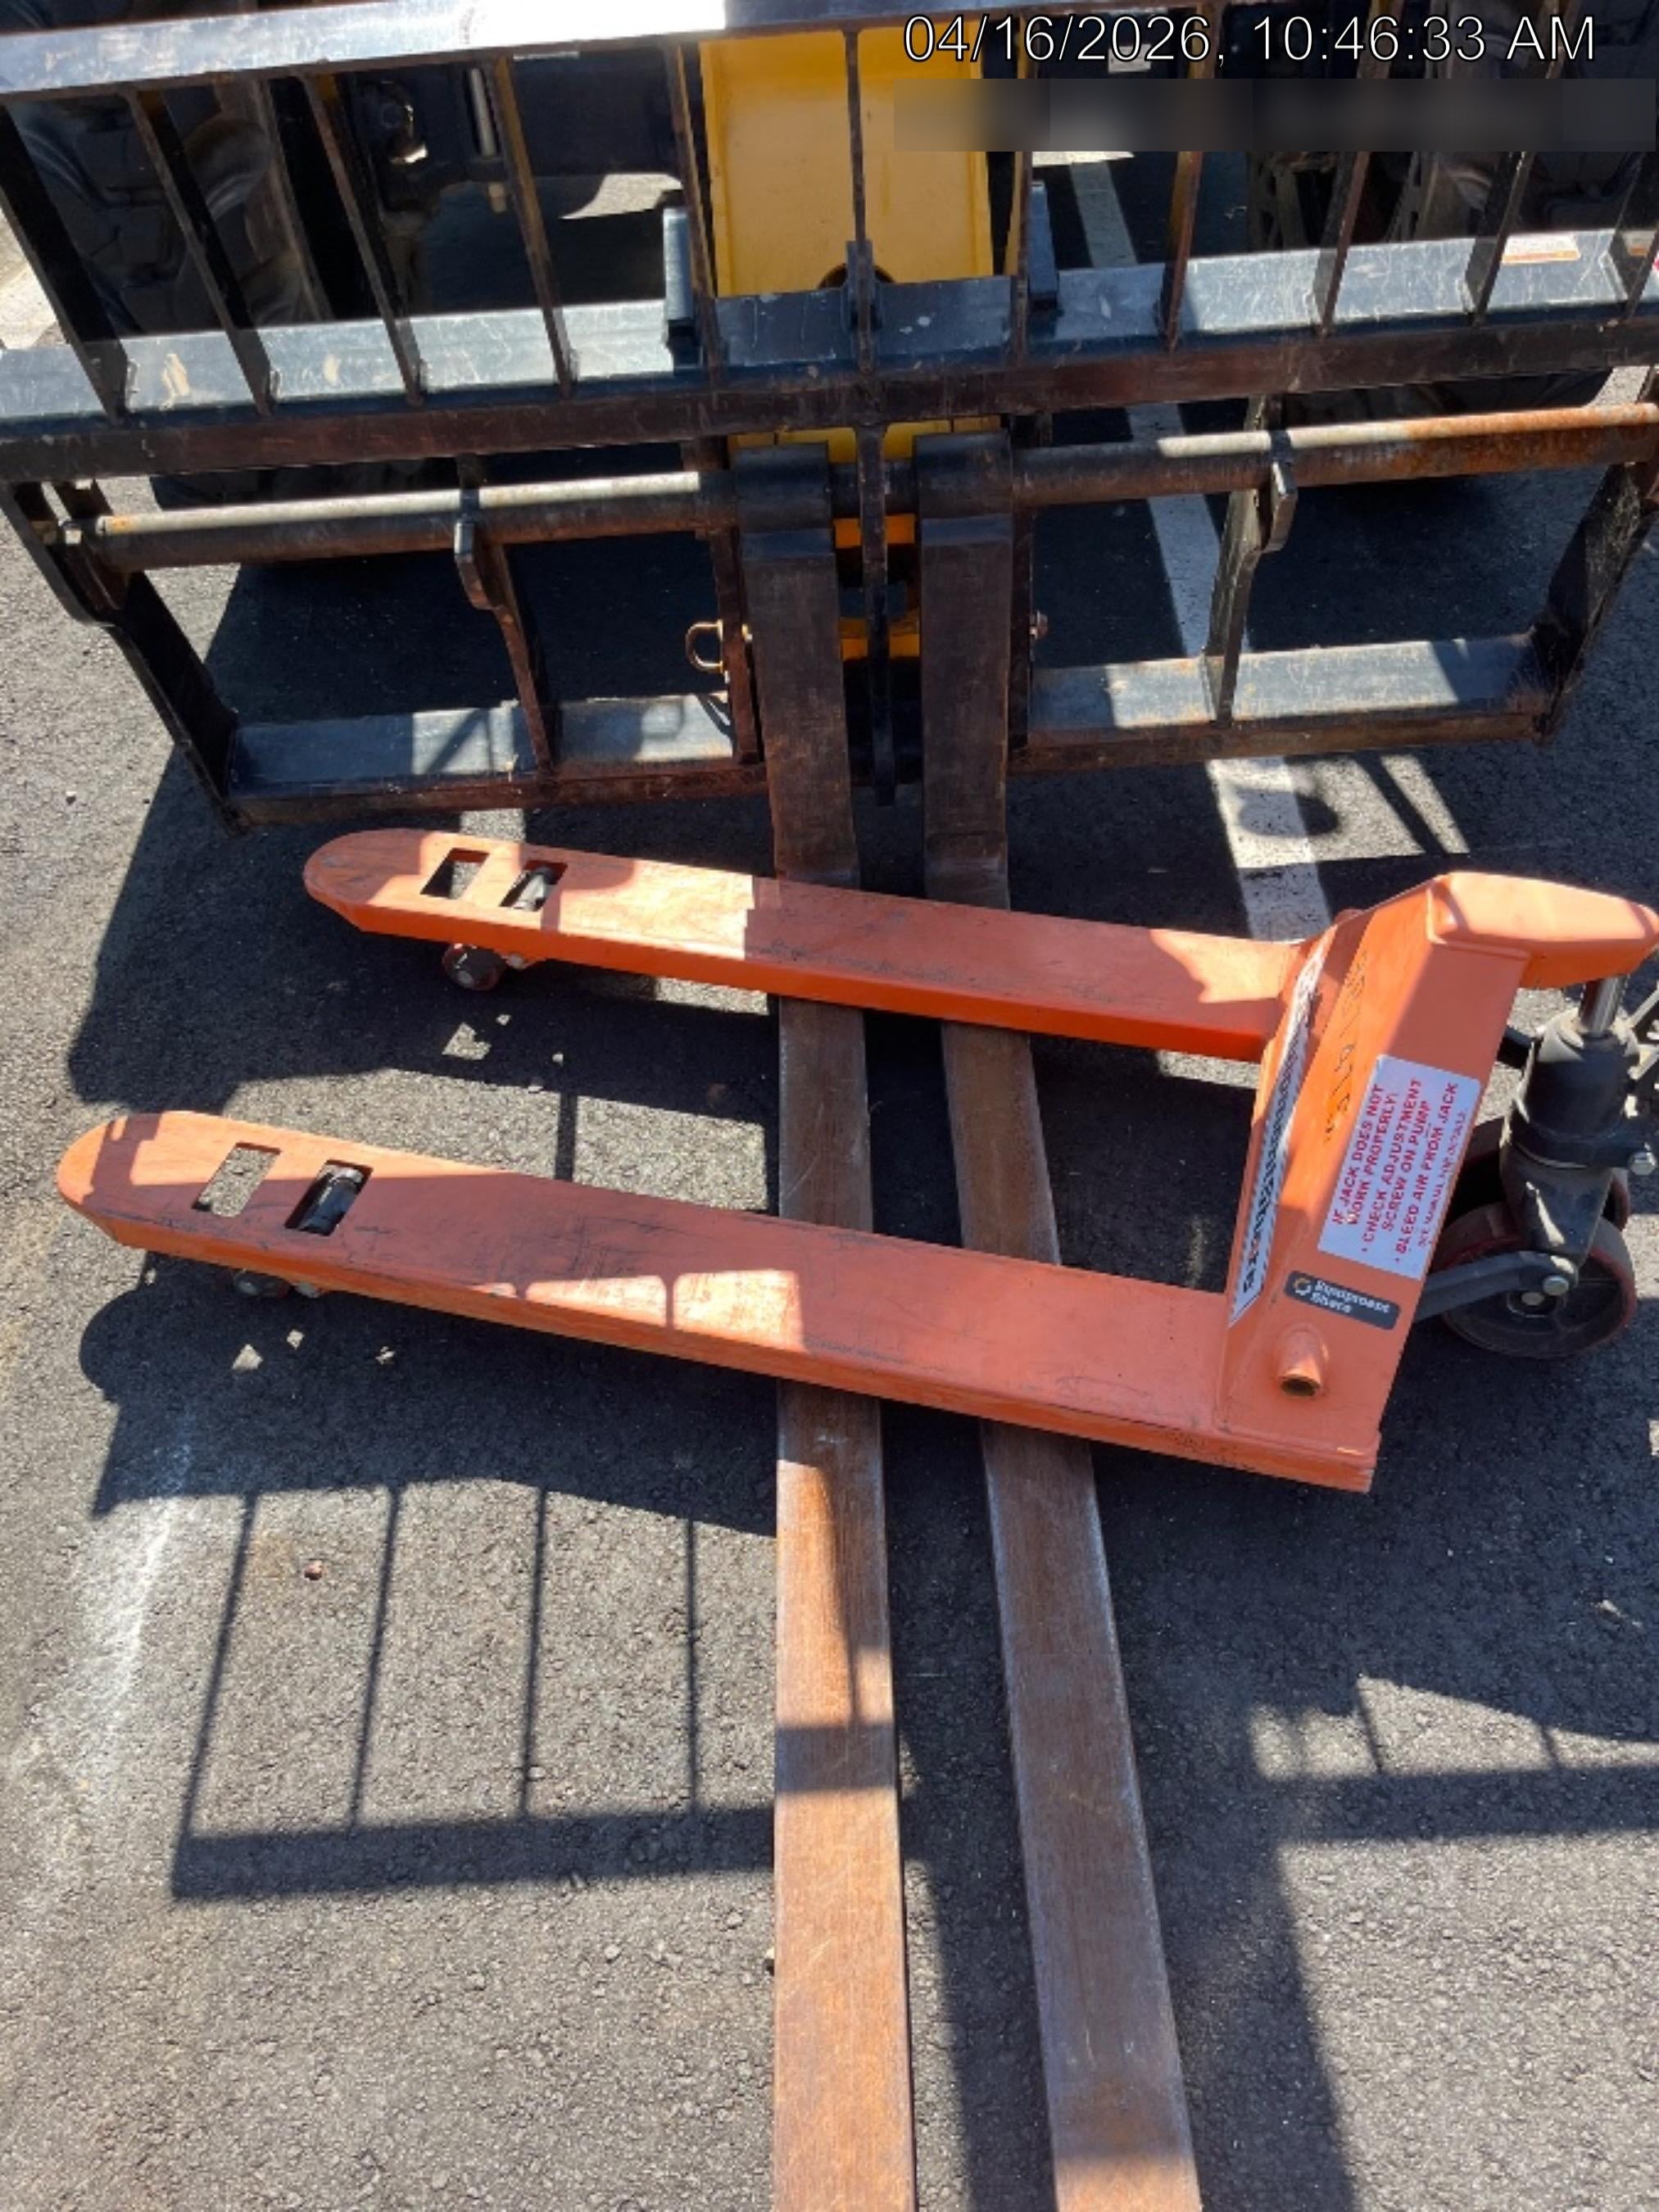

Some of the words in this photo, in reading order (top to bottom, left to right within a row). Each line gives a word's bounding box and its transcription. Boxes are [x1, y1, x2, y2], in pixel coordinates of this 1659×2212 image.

[1331, 1208, 1344, 1225] IF
[1338, 1165, 1359, 1207] JACK
[1351, 1119, 1372, 1162] DOES
[1365, 1082, 1385, 1117] NOT
[1346, 1179, 1371, 1226] WORK
[1362, 1189, 1387, 1244] CHECK
[1380, 1077, 1422, 1185] ADJUSTMENT
[1381, 1176, 1407, 1232] SCREW
[1399, 1149, 1416, 1173] ON
[1408, 1099, 1431, 1145] PUMP
[1394, 1203, 1420, 1255] BLEED
[1412, 1173, 1429, 1201] AIR
[1421, 1126, 1444, 1171] FROM
[1435, 1081, 1457, 1123] JACK
